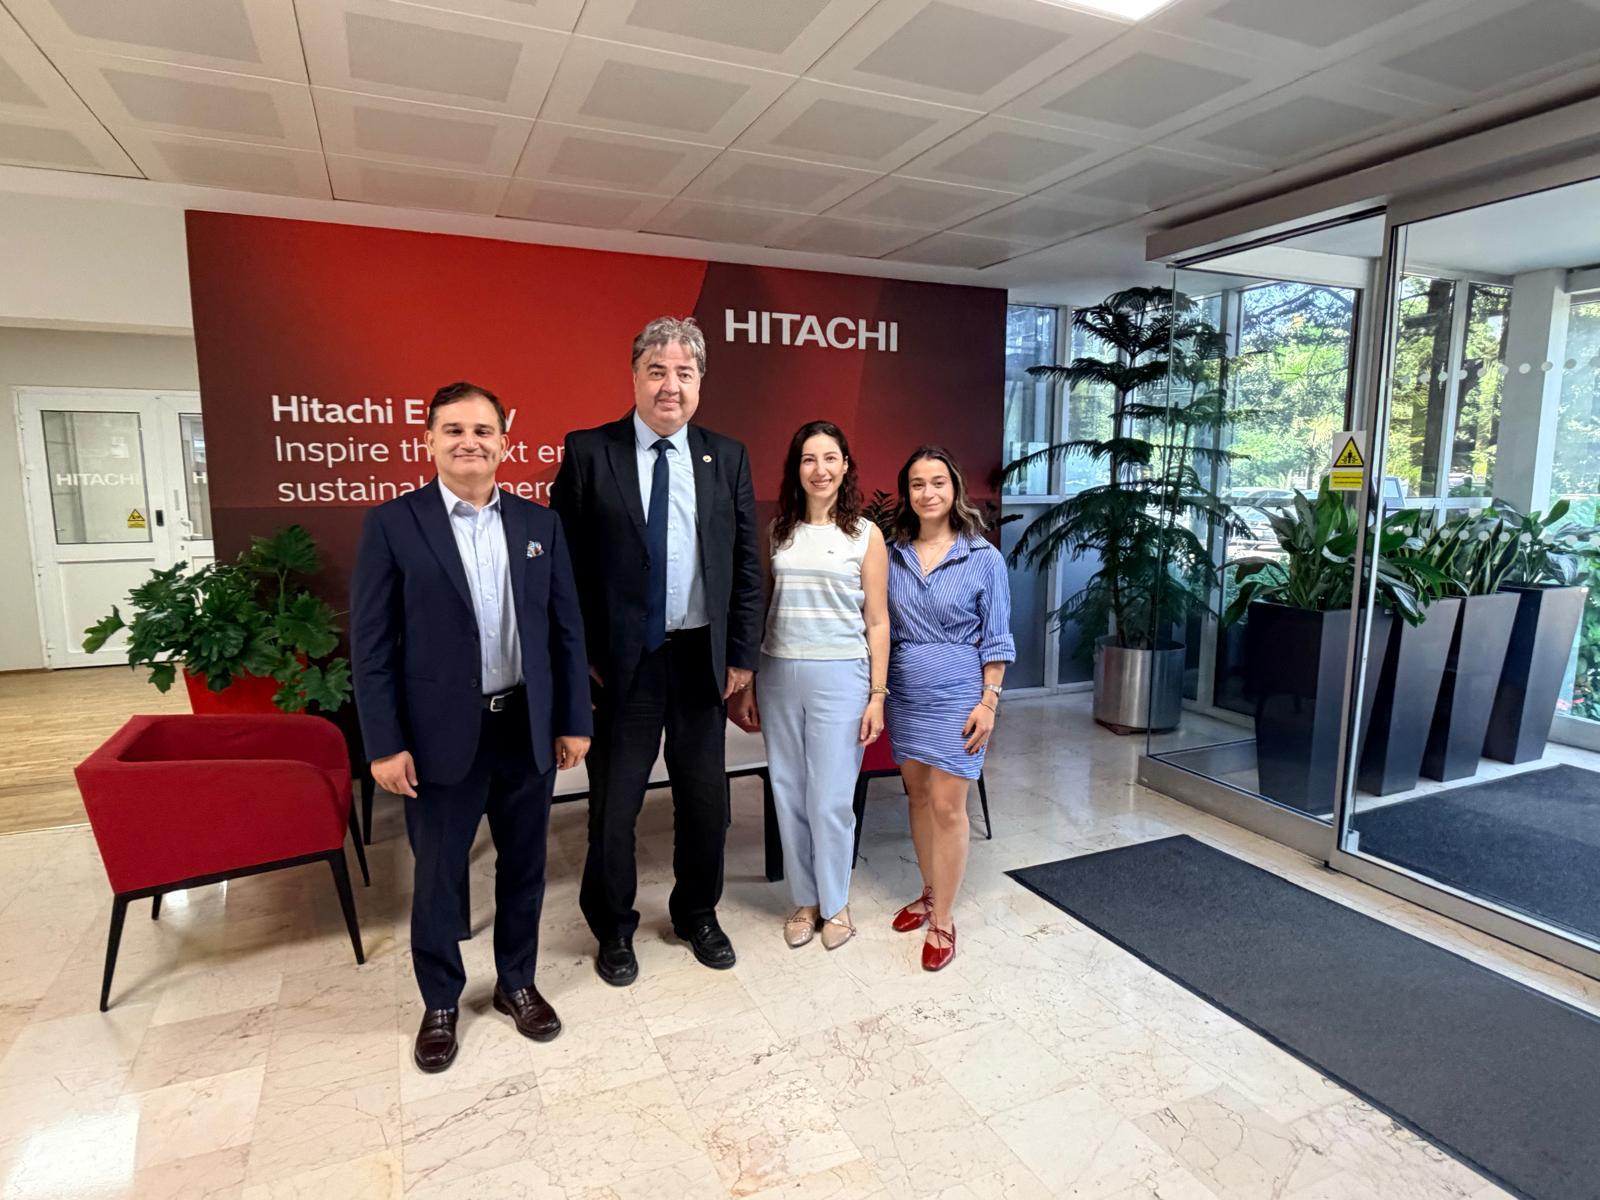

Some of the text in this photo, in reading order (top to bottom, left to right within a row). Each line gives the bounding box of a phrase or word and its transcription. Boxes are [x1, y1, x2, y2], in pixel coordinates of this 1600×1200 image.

[724, 308, 899, 352] HITACHI
[271, 394, 394, 424] Hitachi
[275, 435, 390, 468] Inspire
[399, 437, 432, 463] th
[56, 472, 139, 486] HITACHI
